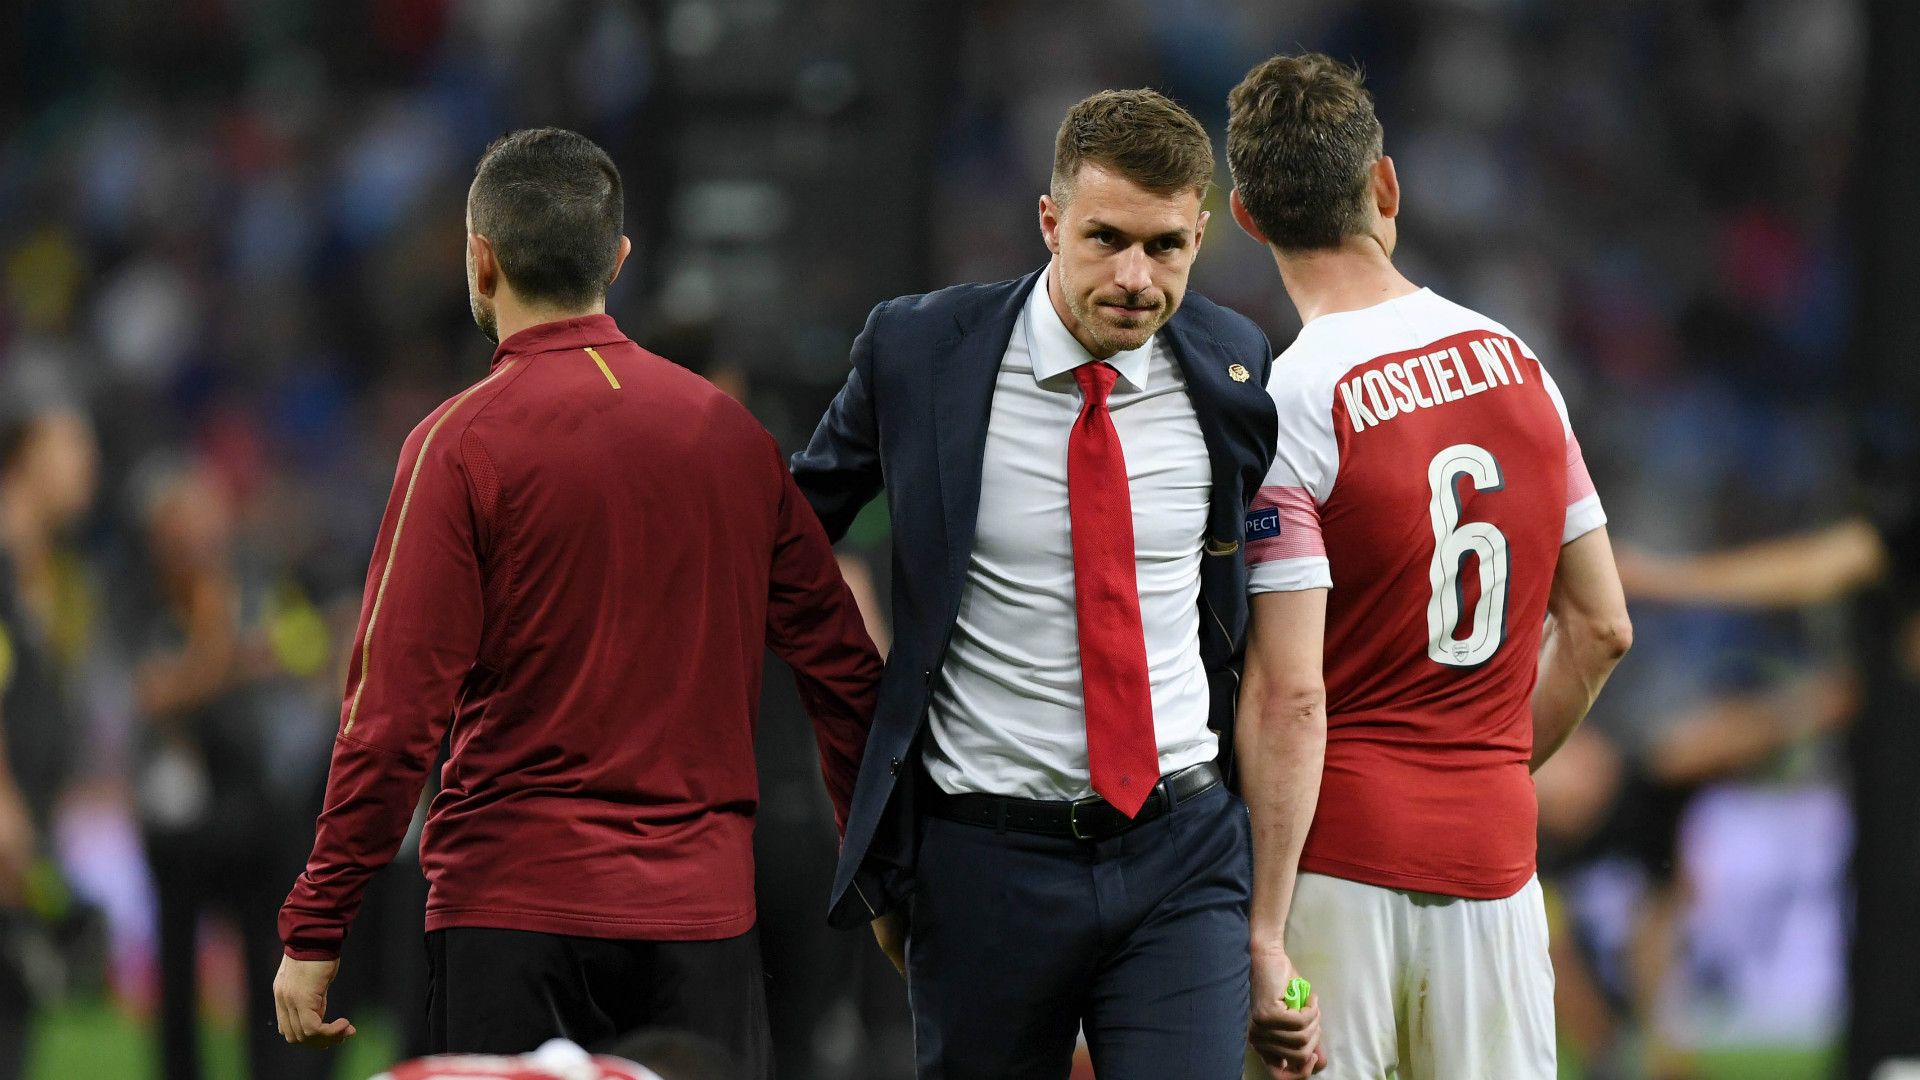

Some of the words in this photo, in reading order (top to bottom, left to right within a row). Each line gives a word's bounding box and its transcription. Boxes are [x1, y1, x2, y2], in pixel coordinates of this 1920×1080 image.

[1340, 338, 1523, 433] KOSCIELNY
[1245, 515, 1278, 533] PECT
[1427, 443, 1508, 667] 6
